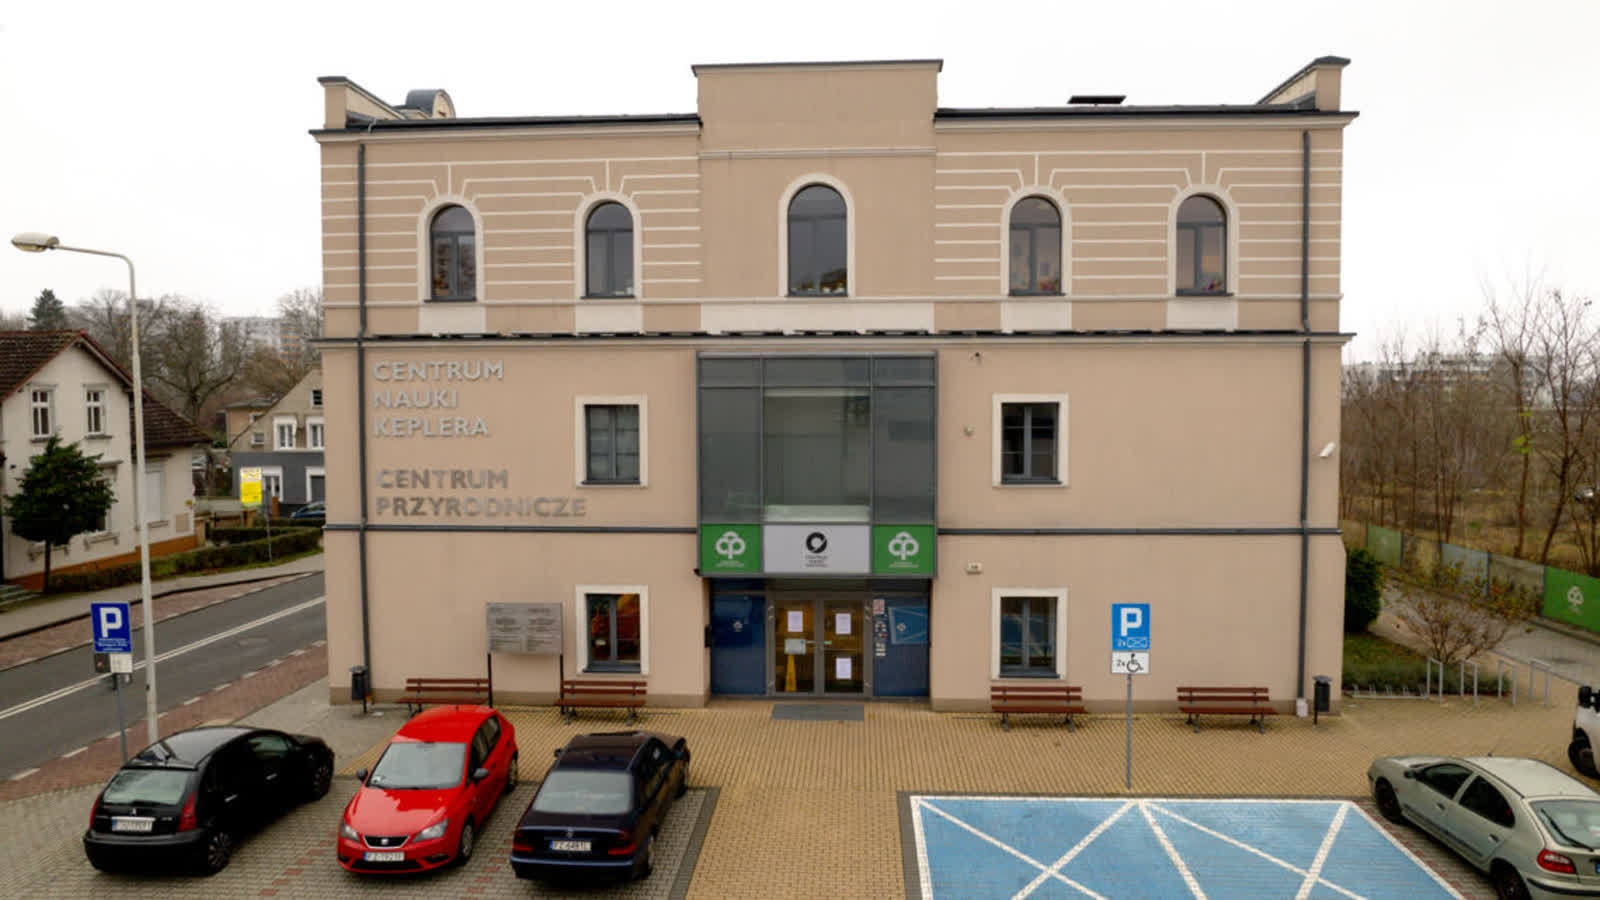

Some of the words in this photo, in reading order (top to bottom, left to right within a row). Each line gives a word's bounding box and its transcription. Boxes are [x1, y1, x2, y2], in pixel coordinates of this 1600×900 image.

[374, 359, 504, 381] CENTRUM
[373, 389, 458, 409] NAUKI
[374, 416, 489, 437] KEPLERA
[377, 469, 508, 489] CENTRUM
[377, 496, 586, 517] PRZYRODNICZE
[100, 607, 122, 638] P
[1120, 608, 1142, 636] P
